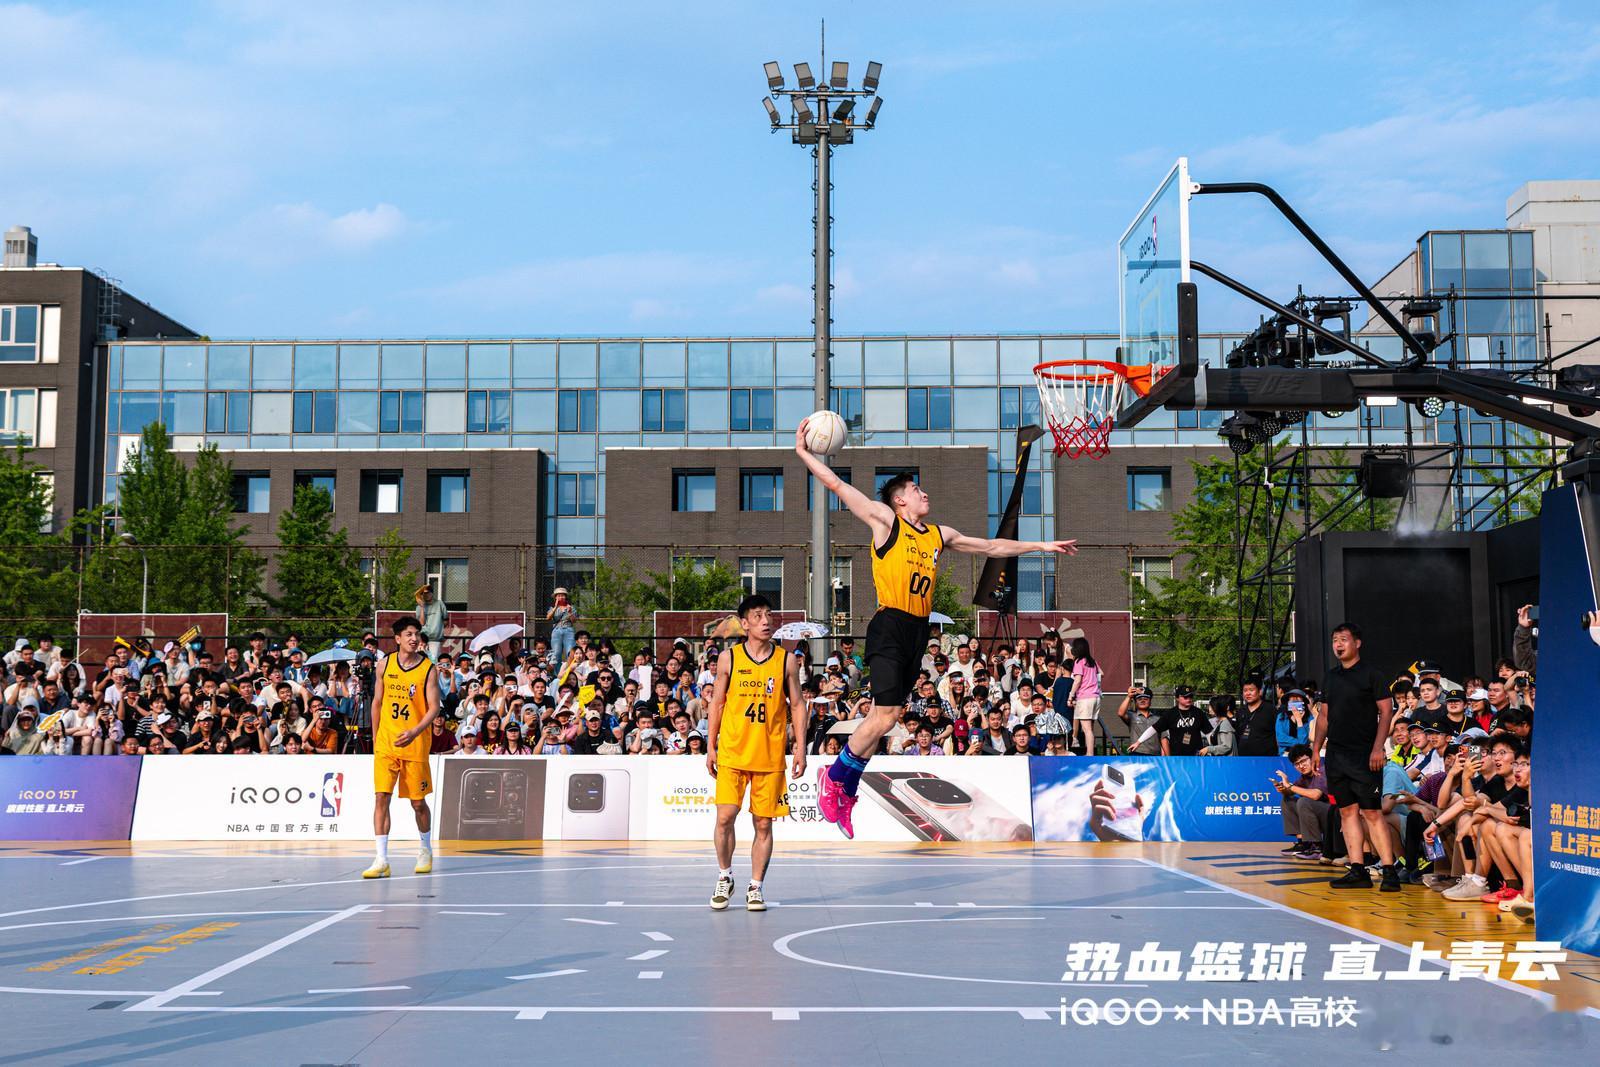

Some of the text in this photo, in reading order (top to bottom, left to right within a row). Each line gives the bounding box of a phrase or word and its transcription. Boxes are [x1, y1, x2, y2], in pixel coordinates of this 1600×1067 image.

[909, 571, 931, 599] 00
[391, 702, 411, 721] 34
[744, 702, 766, 724] 48
[18, 790, 78, 800] iQOO 15T
[230, 786, 303, 804] iQOO
[673, 787, 709, 795] iQOO 15
[1213, 792, 1271, 802] iQOO 15T
[663, 795, 716, 805] ULTRA
[1204, 806, 1282, 816] 旗舰性能 直上青云
[1549, 802, 1600, 830] 热血篮球
[226, 823, 339, 833] NBA 中国官方手机
[1549, 830, 1600, 860] 直上青云
